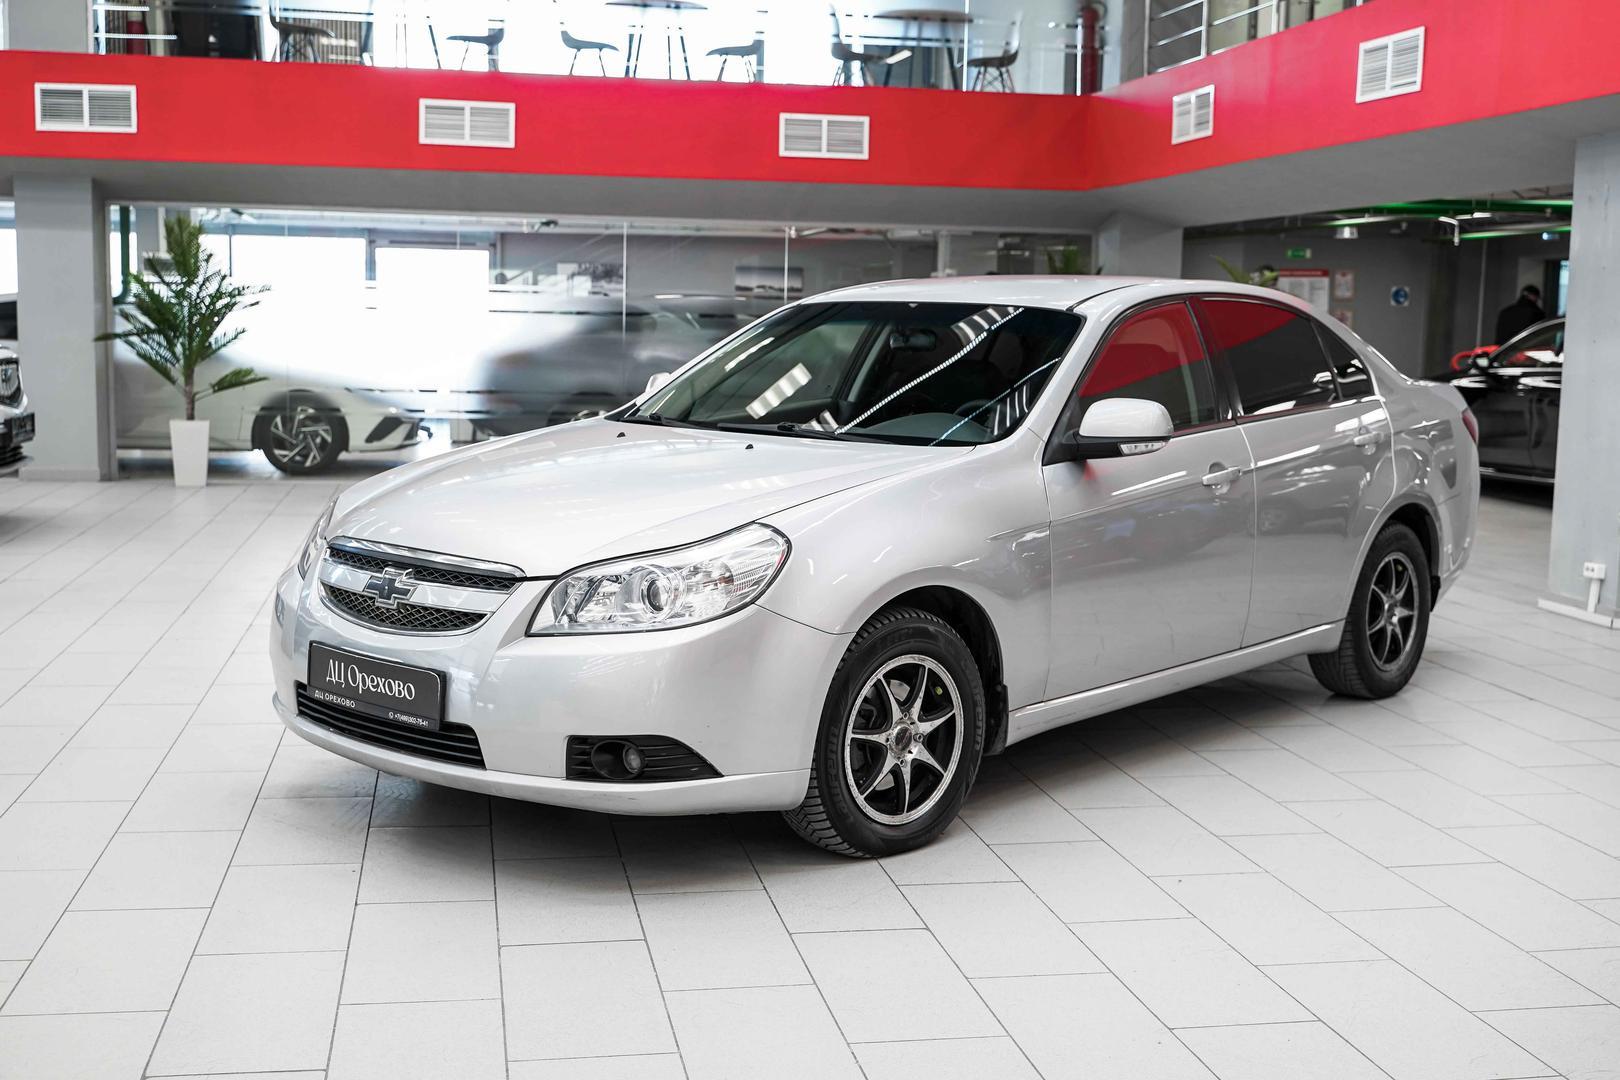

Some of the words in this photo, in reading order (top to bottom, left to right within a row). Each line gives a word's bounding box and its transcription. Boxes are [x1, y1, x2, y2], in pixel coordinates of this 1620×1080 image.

[326, 658, 345, 688] ДЦ
[347, 664, 416, 700] Орехово
[324, 692, 356, 708] ОРЕХОВО
